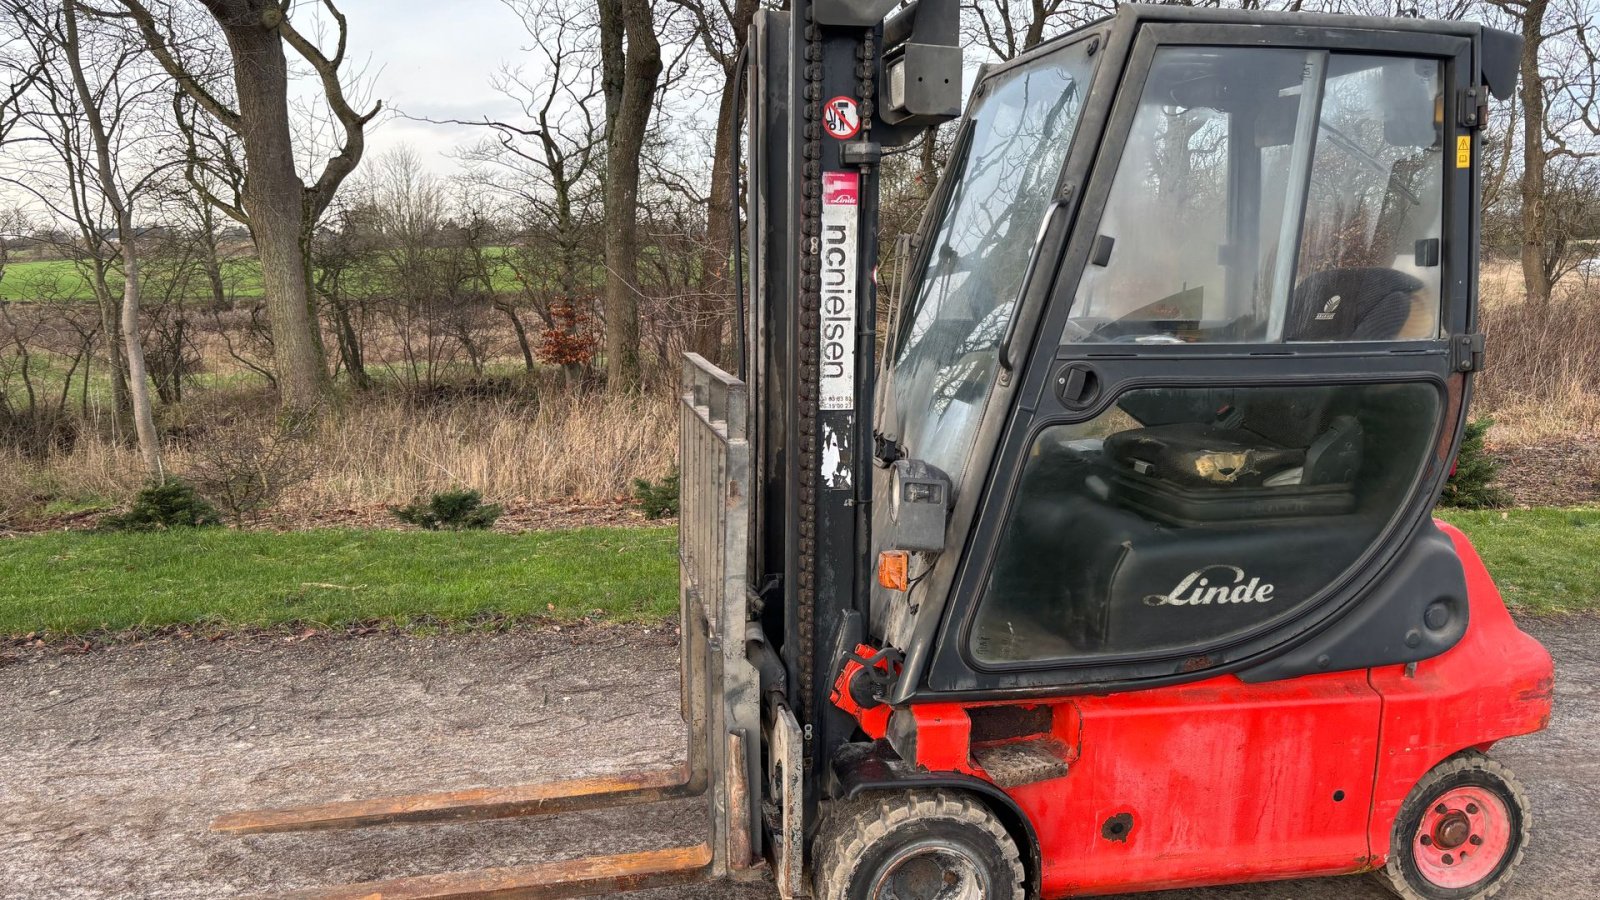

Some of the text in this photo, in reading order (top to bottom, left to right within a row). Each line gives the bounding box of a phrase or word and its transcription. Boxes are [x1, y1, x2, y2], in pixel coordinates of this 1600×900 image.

[831, 194, 856, 204] Linde
[823, 225, 852, 379] ncnielsen
[1143, 564, 1275, 606] Linde
